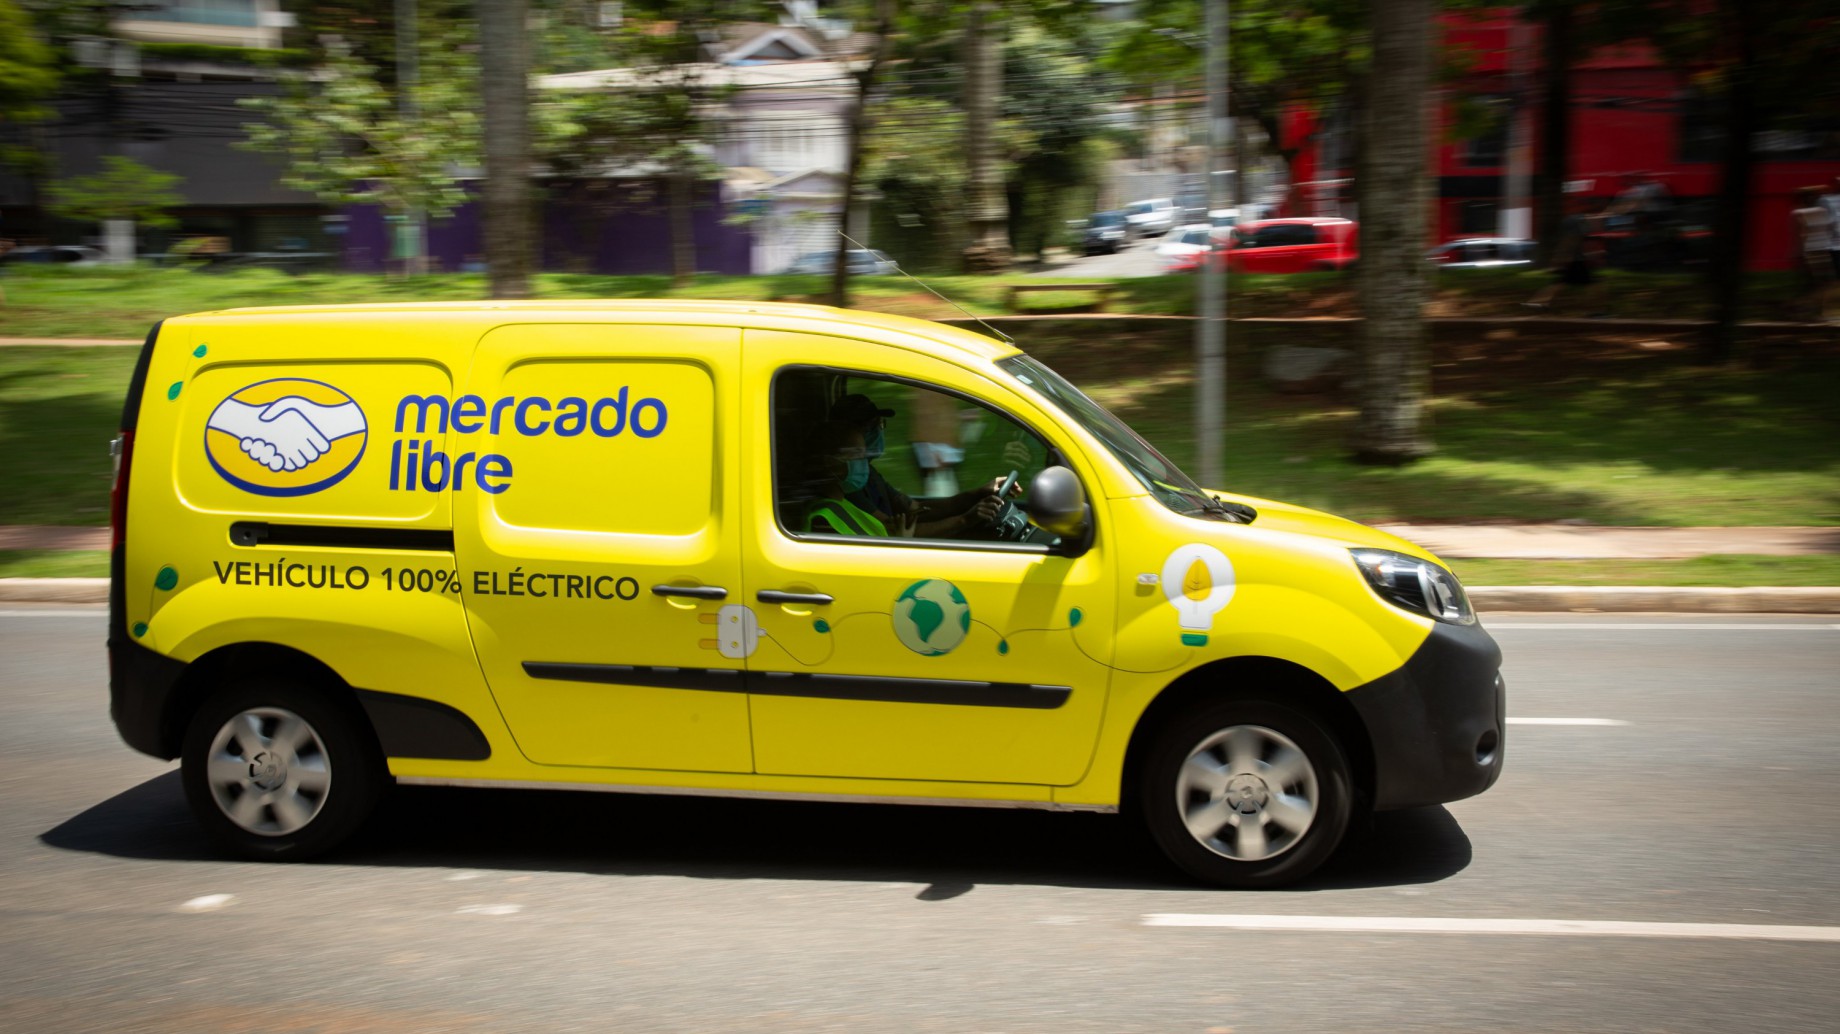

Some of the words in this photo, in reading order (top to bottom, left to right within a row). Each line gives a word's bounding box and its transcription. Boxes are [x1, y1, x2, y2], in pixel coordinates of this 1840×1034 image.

[394, 386, 668, 438] mercado
[389, 439, 513, 494] libre
[213, 557, 370, 591] VEHÍCULO
[380, 567, 462, 594] 100%
[473, 567, 640, 601] ELÉCTRICO
